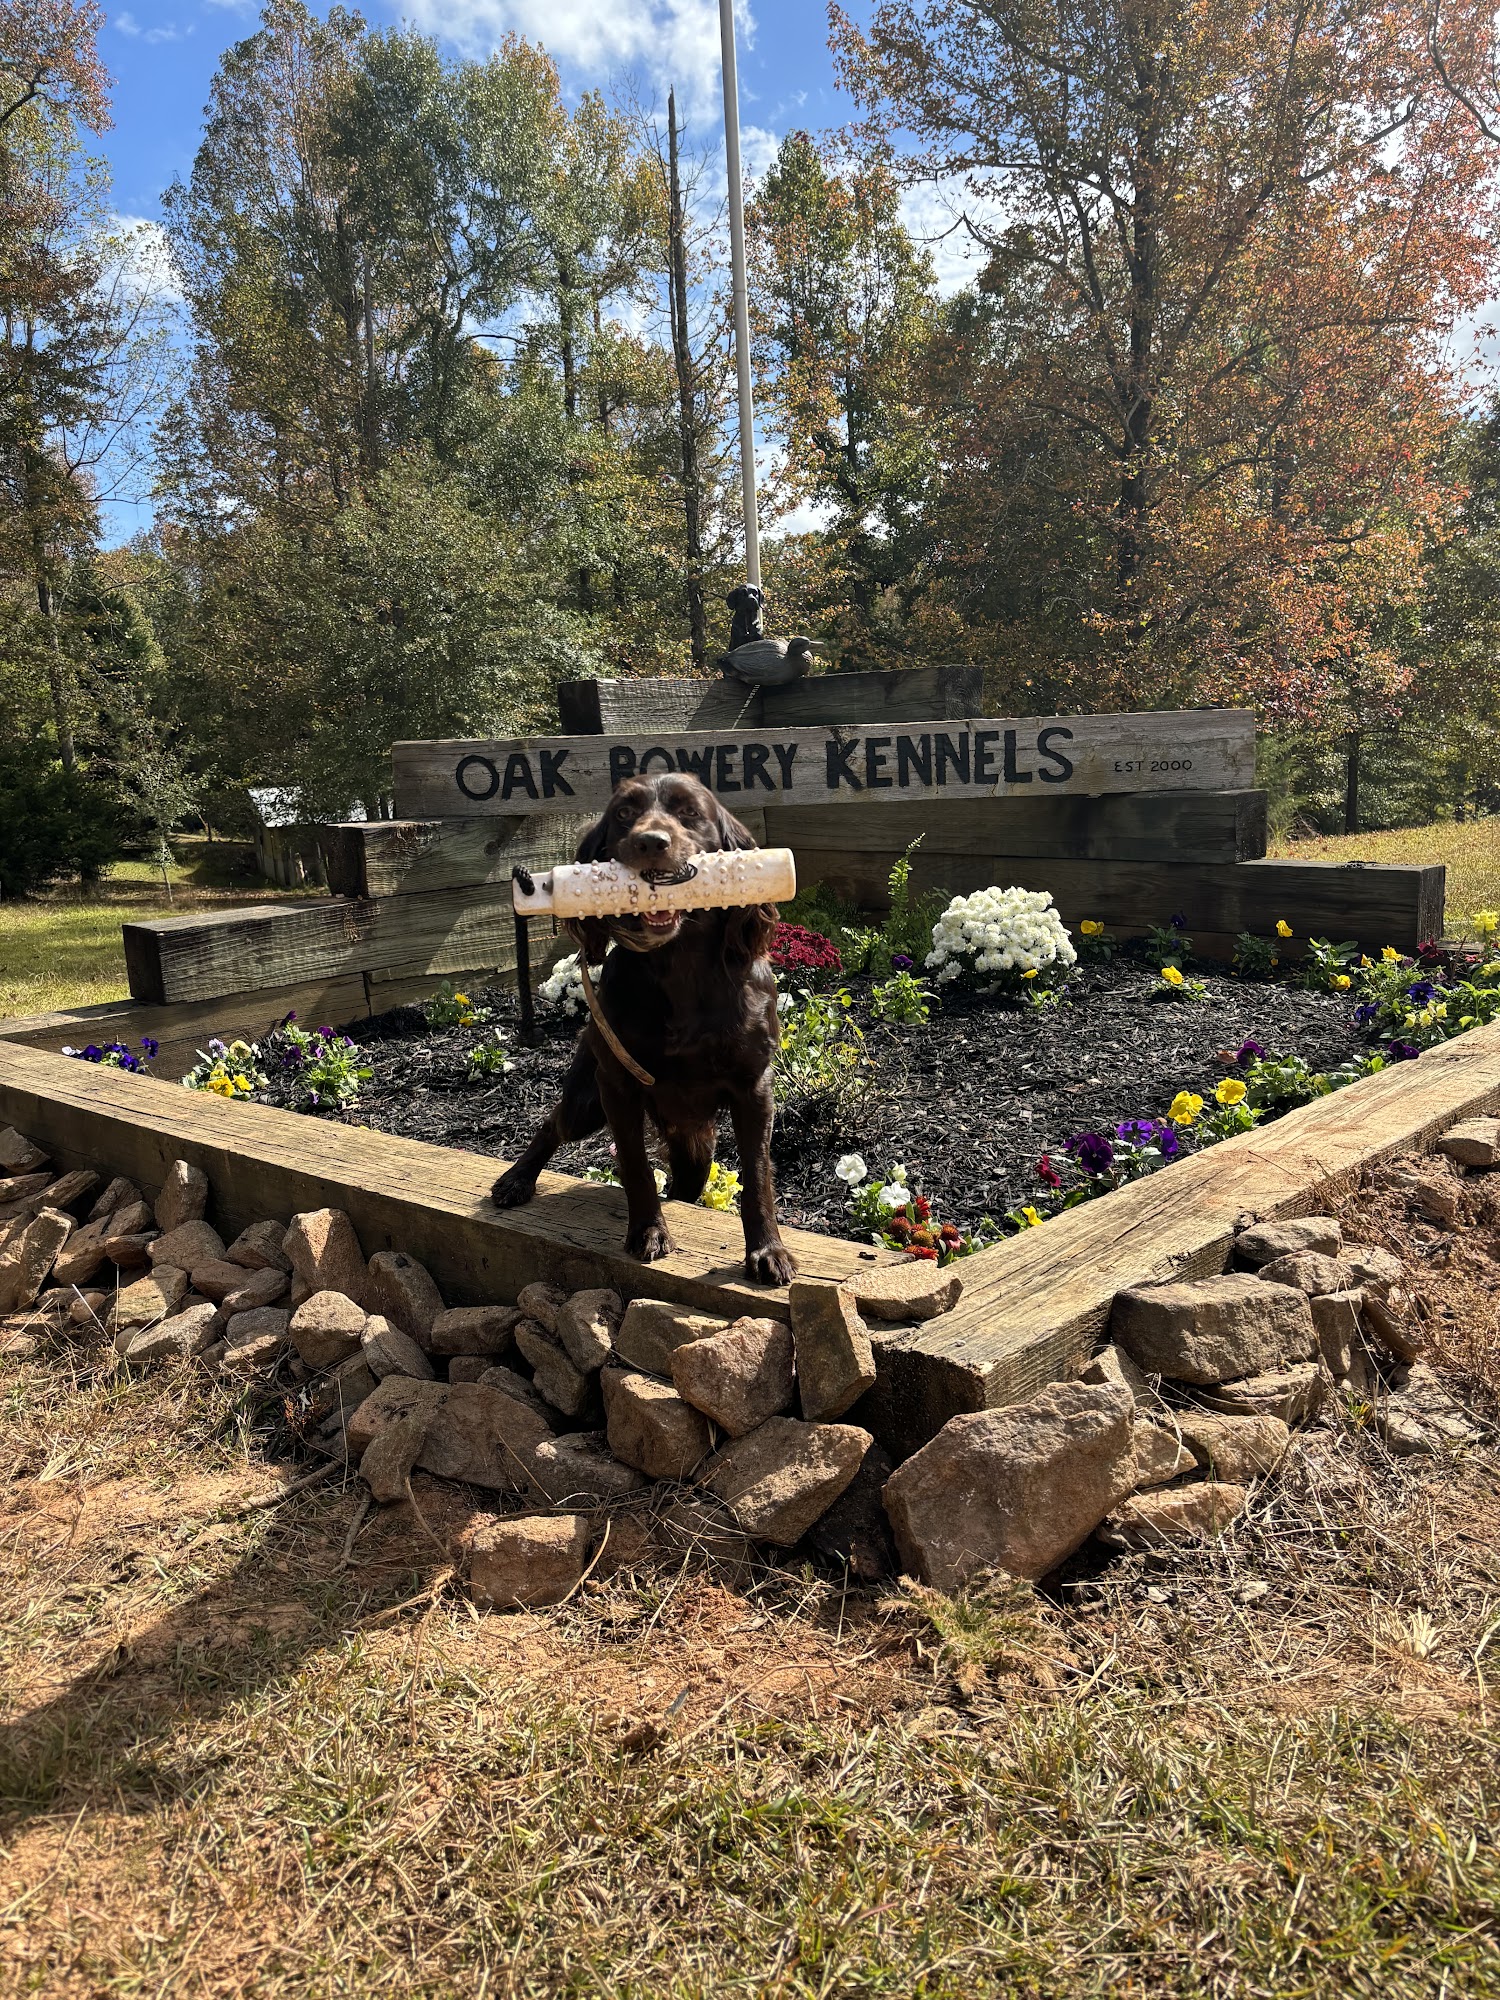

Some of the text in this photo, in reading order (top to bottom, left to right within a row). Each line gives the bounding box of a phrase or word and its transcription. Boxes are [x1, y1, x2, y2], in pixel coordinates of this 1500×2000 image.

[455, 749, 576, 801] OAK
[825, 726, 1075, 790] KENNELS
[1114, 759, 1193, 773] EST 2000
